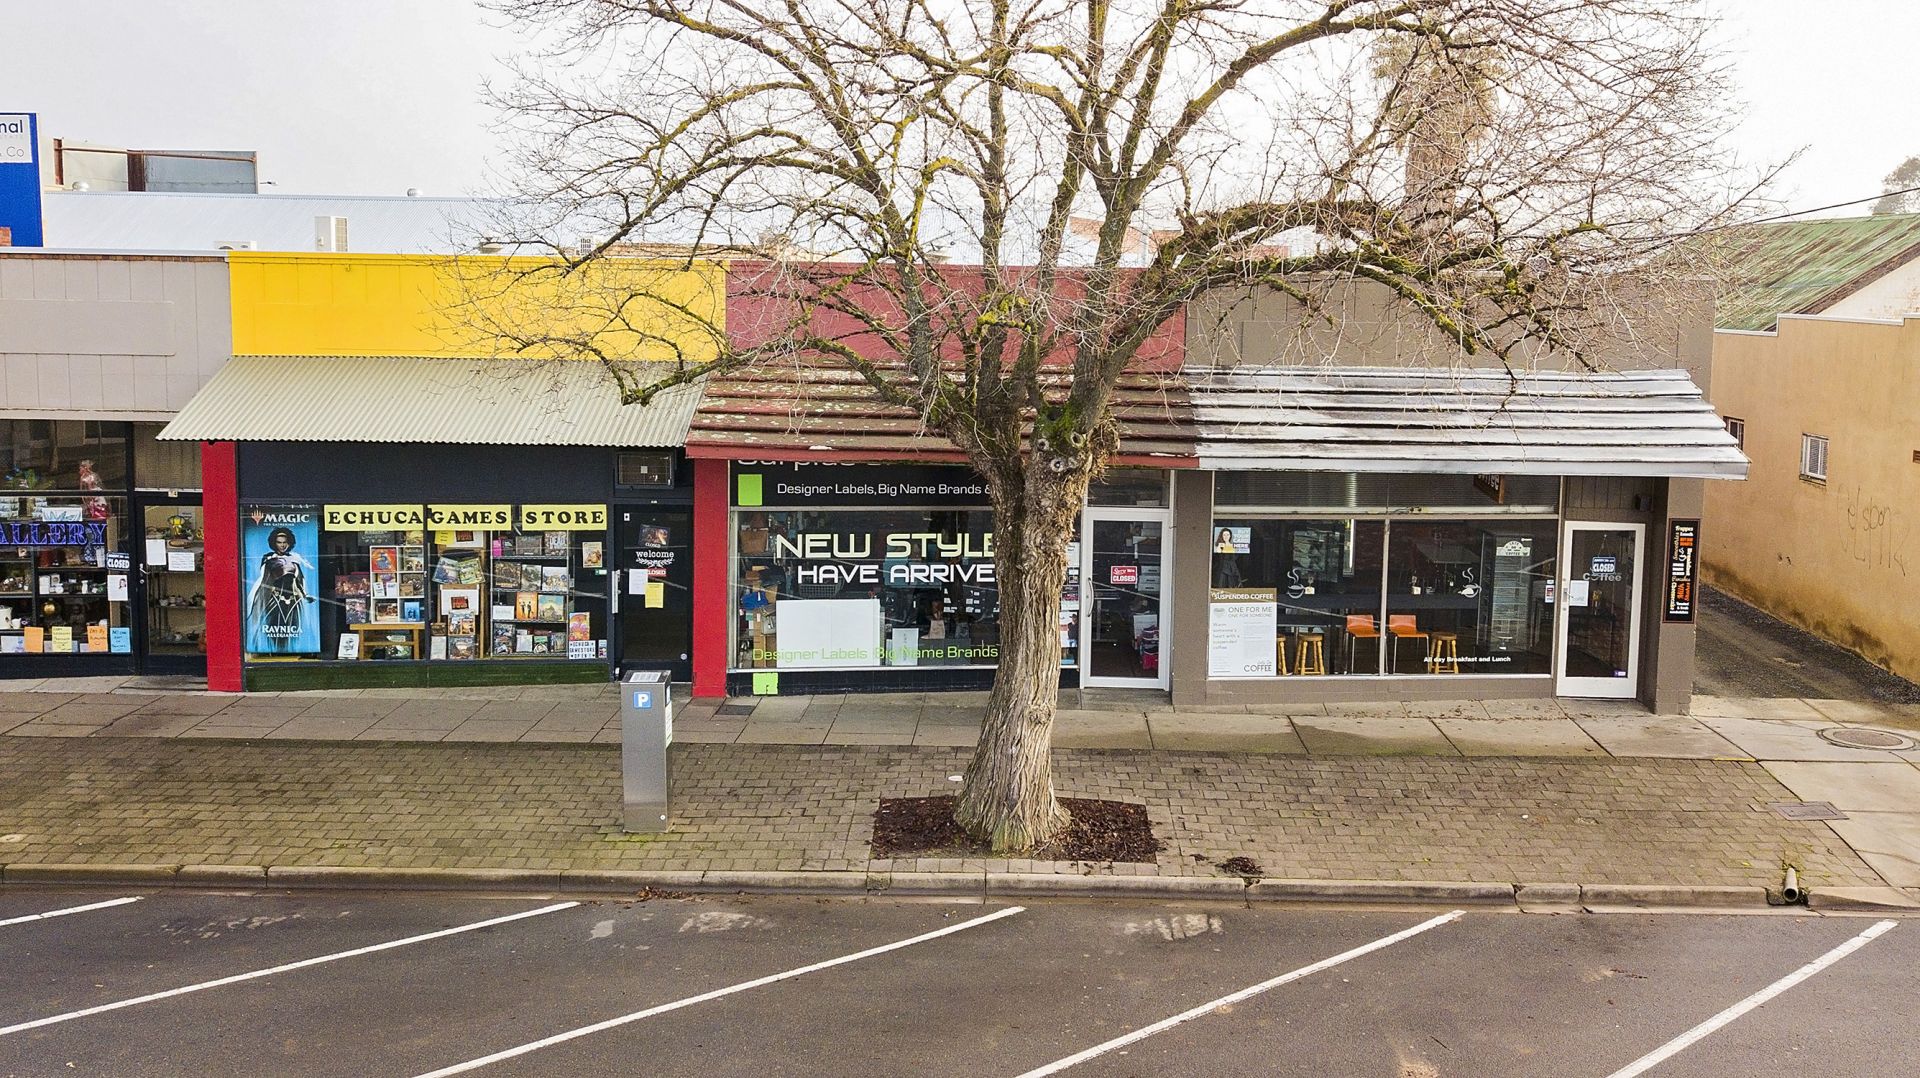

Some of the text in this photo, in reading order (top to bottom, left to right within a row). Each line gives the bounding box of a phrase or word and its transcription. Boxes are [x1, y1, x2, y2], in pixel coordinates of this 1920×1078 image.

[6, 146, 24, 157] Co
[777, 484, 832, 496] Designer
[900, 484, 936, 494] Name
[938, 484, 982, 494] Brands
[264, 514, 310, 523] MAGIC
[328, 511, 604, 524] ECHUCA GAMES STORE
[776, 533, 870, 559] NEW
[107, 558, 130, 568] CLOSED
[1593, 563, 1614, 572] CLOSED
[798, 565, 878, 584] HAVE
[262, 624, 303, 633] RAVNICA
[753, 646, 998, 660] Designer Labels Big Name Brands
[638, 694, 648, 707] P
